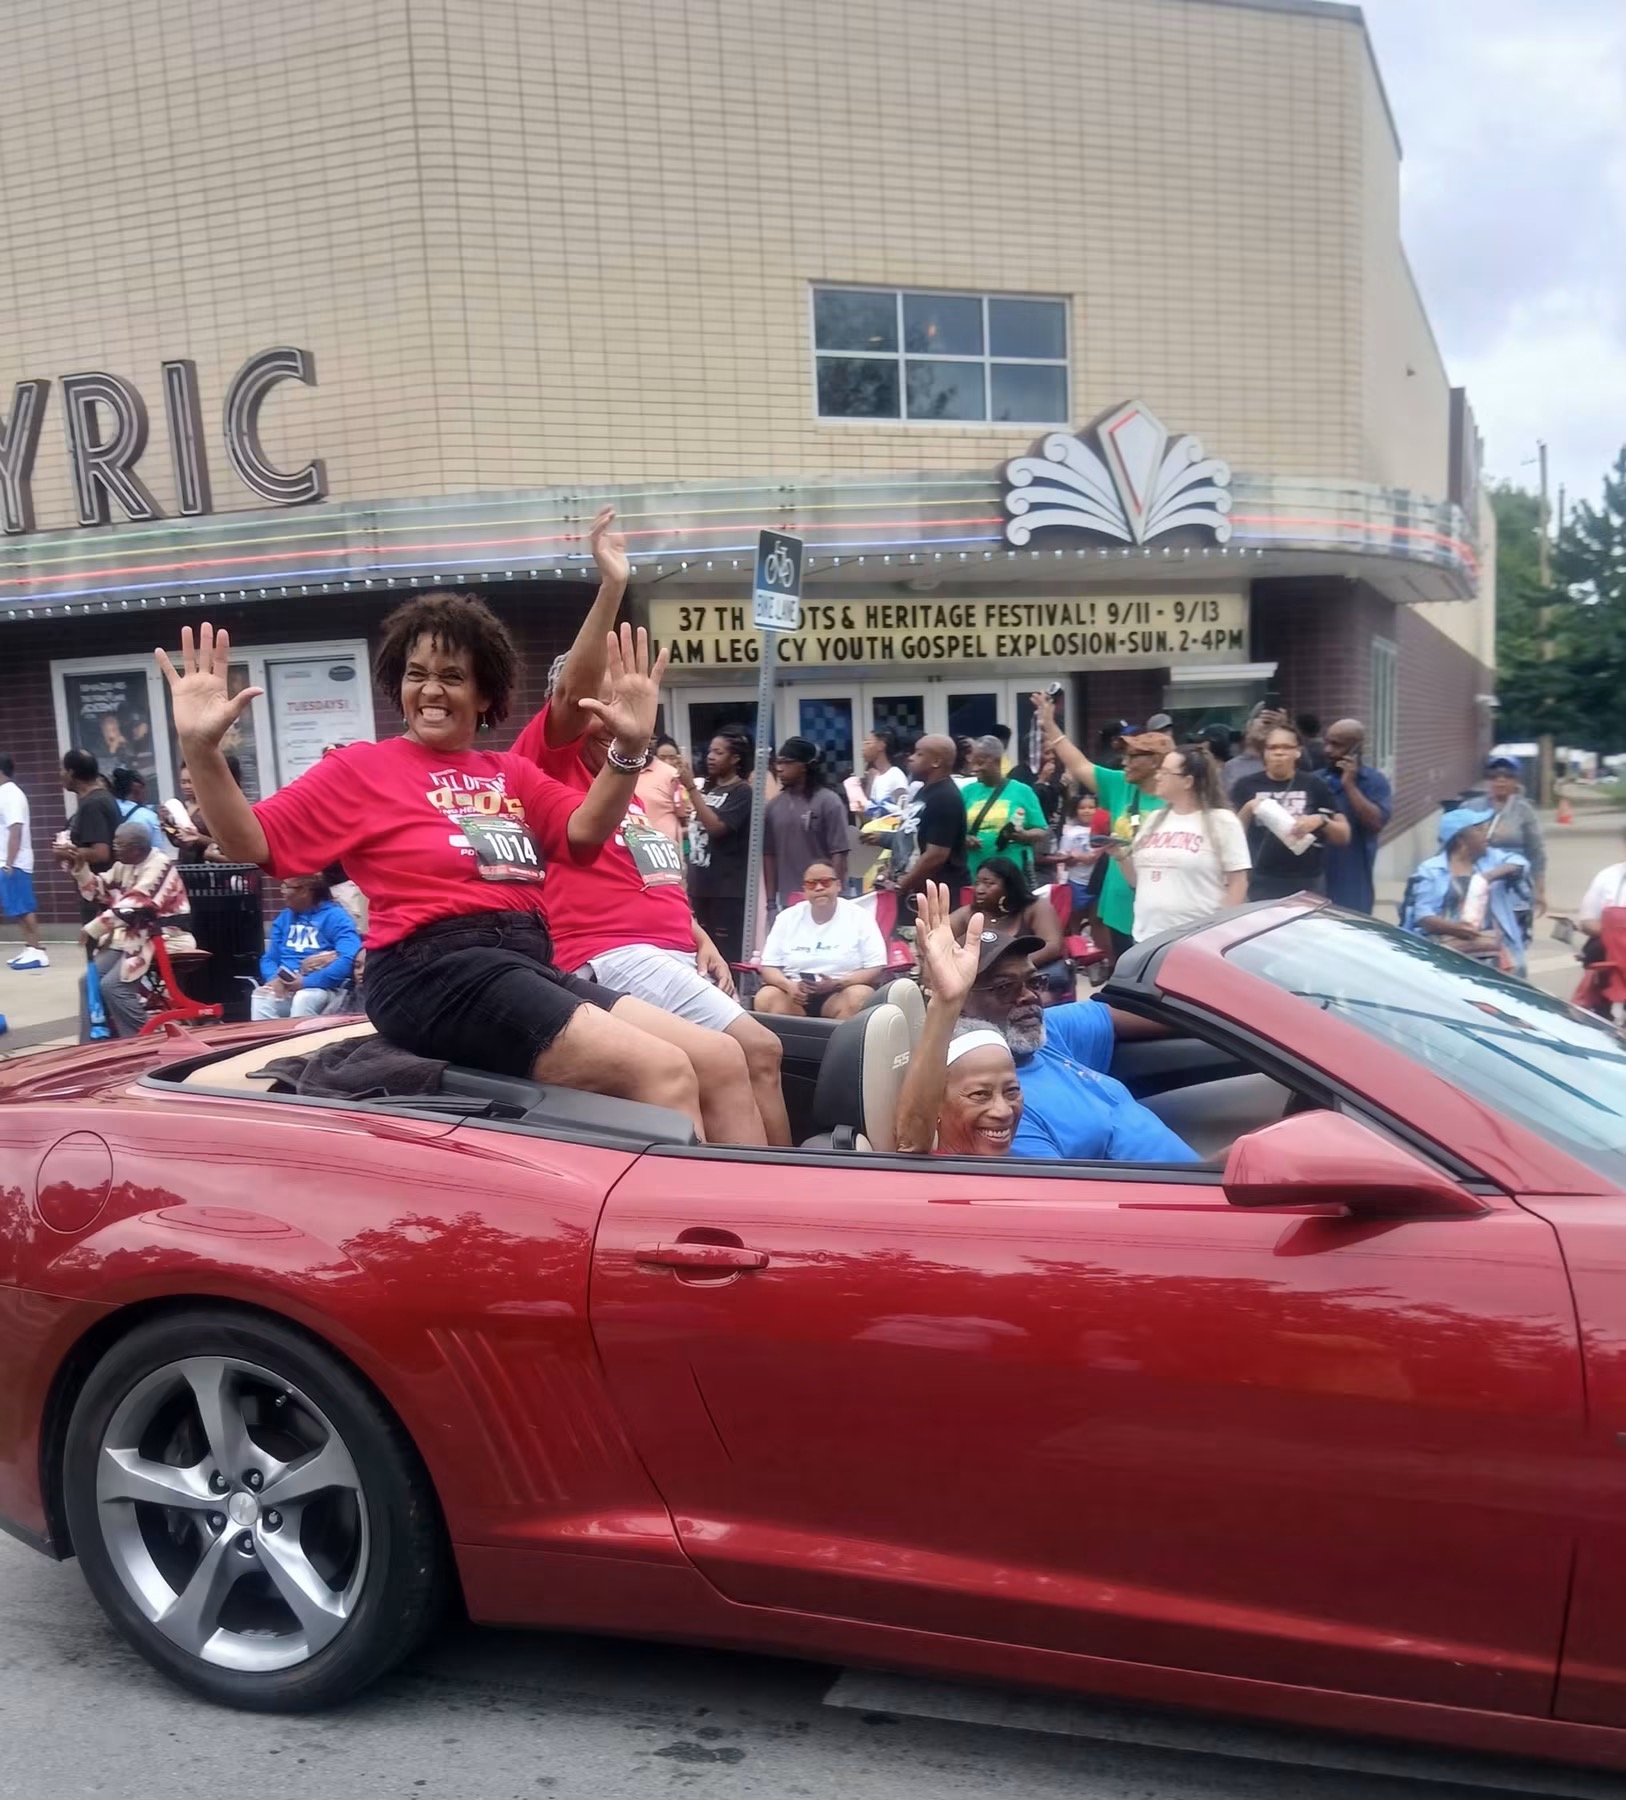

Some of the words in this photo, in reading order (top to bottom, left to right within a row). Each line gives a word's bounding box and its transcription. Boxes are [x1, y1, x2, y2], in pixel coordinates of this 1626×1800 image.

[679, 607, 706, 631] 37
[715, 607, 744, 630] TH
[841, 606, 855, 629] &
[866, 605, 976, 628] HERITAGE
[985, 603, 1096, 627] FESTIVAL!
[1107, 602, 1150, 625] 9/11
[1174, 601, 1220, 623] 9/13
[669, 639, 704, 663] AM
[715, 637, 807, 663] LEGCY
[816, 637, 894, 661] YOUTH
[901, 634, 988, 659] GOSPEL
[1179, 629, 1244, 652] 2-4PM
[484, 832, 538, 866] 1014
[642, 843, 681, 870] 1015
